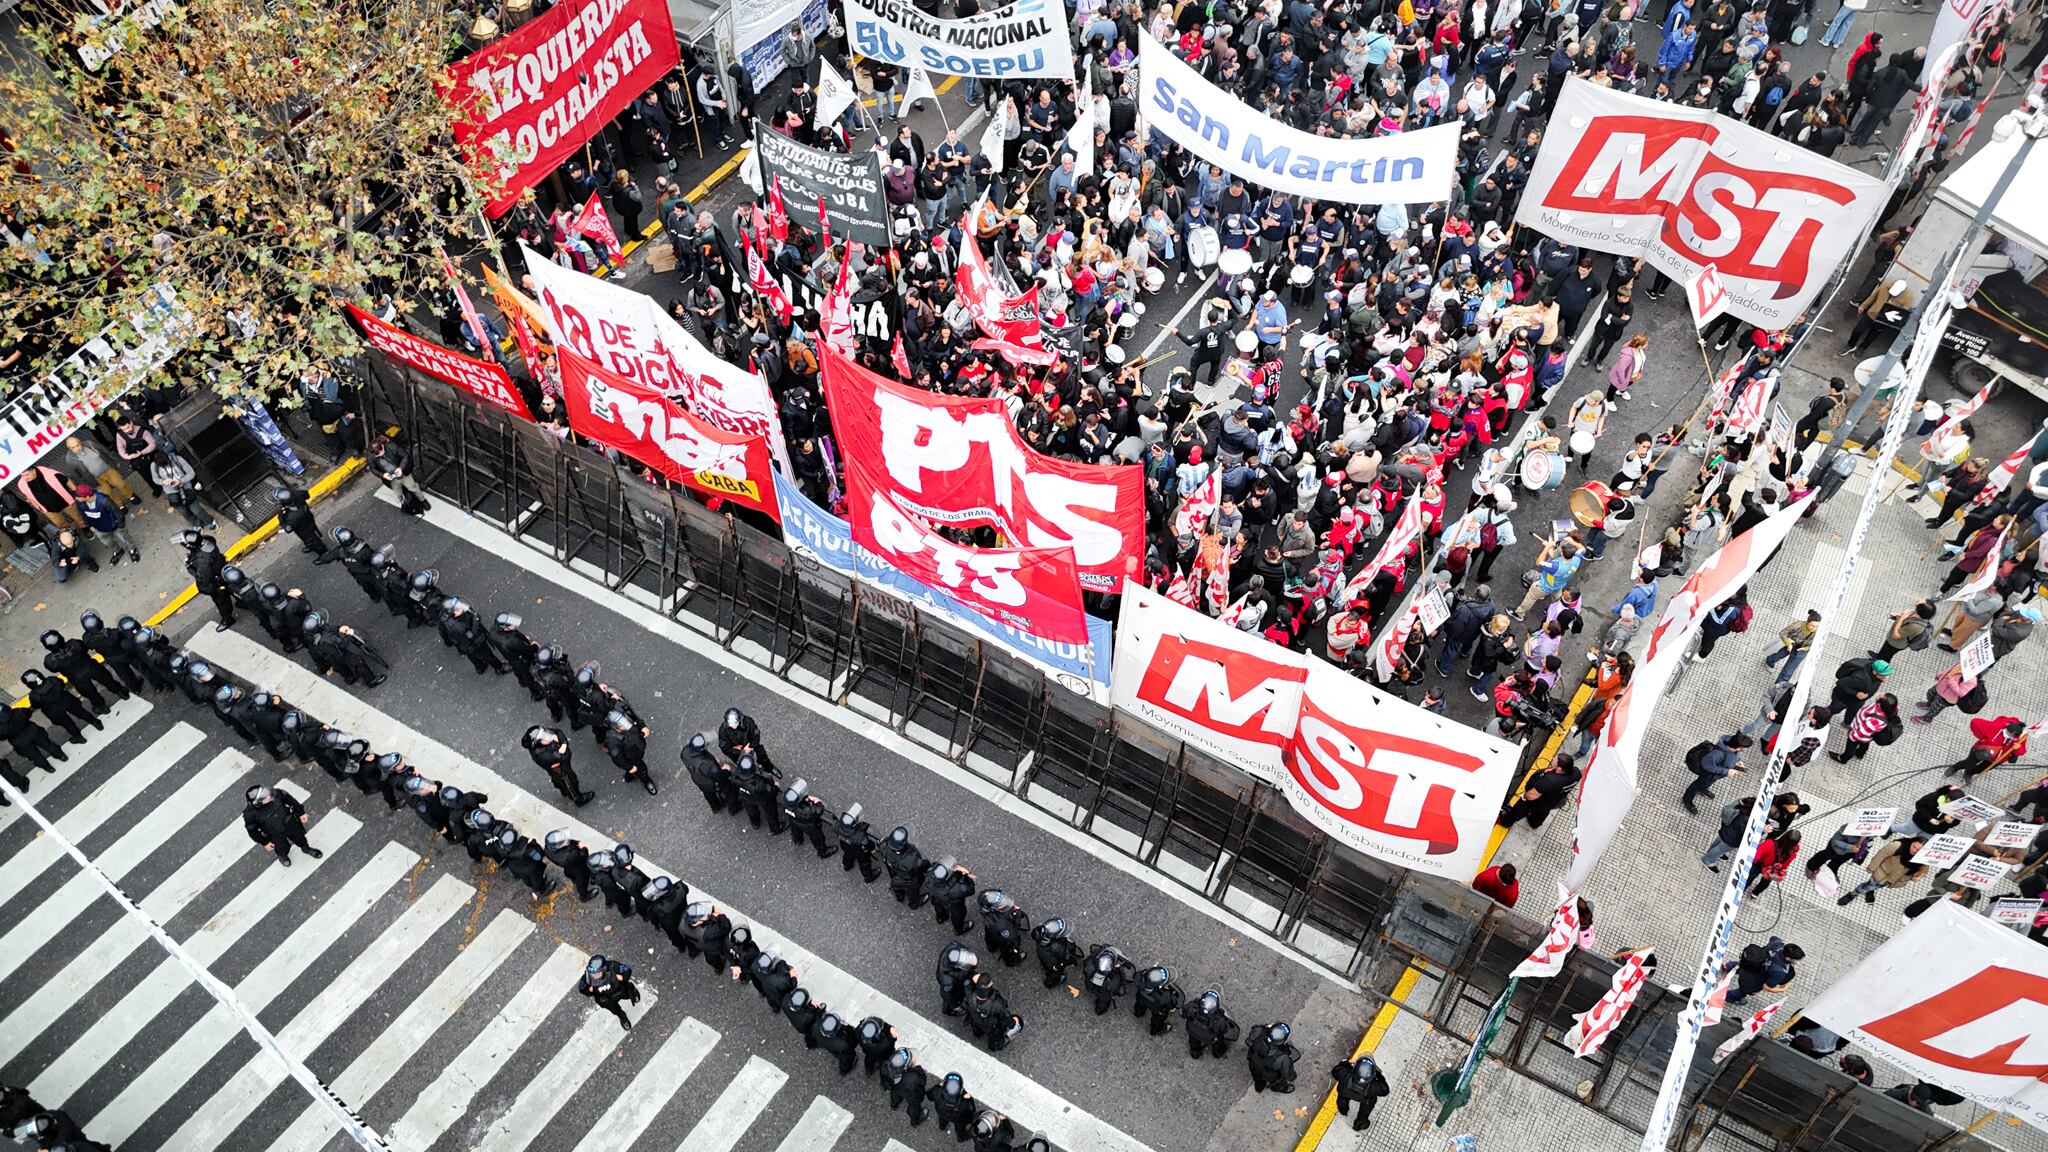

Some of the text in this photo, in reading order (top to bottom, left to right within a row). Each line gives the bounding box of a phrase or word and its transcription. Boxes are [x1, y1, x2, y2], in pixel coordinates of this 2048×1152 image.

[948, 17, 1052, 50] NACIONAL
[473, 0, 632, 123] IZQUIERD
[920, 46, 1046, 77] SOEPU
[1153, 76, 1229, 151] San
[762, 132, 850, 177] ESTUDIANTES
[815, 174, 878, 194] SOCIALES
[832, 192, 870, 212] UBA
[1571, 132, 1824, 268] MST
[1540, 212, 1781, 319] Movimiento Socialista de lo ajadores
[361, 318, 504, 385] CONVERGENCIA
[597, 318, 637, 350] DE
[1943, 332, 1966, 345] Entre
[1955, 330, 1987, 346] Avenida
[1966, 348, 1980, 357] 100
[372, 335, 516, 404] SOCIALISTA
[699, 469, 753, 496] CABA
[942, 512, 961, 520] LOS
[870, 492, 1028, 608] PTS
[1164, 653, 1457, 830] MST
[1140, 703, 1223, 753] Movimiento
[1229, 750, 1294, 792] Socialista
[1314, 805, 1333, 827] los
[1338, 822, 1443, 869] Trabajadores
[1846, 1029, 1945, 1088] Movimiento
[1952, 1085, 2032, 1112] Socialista
